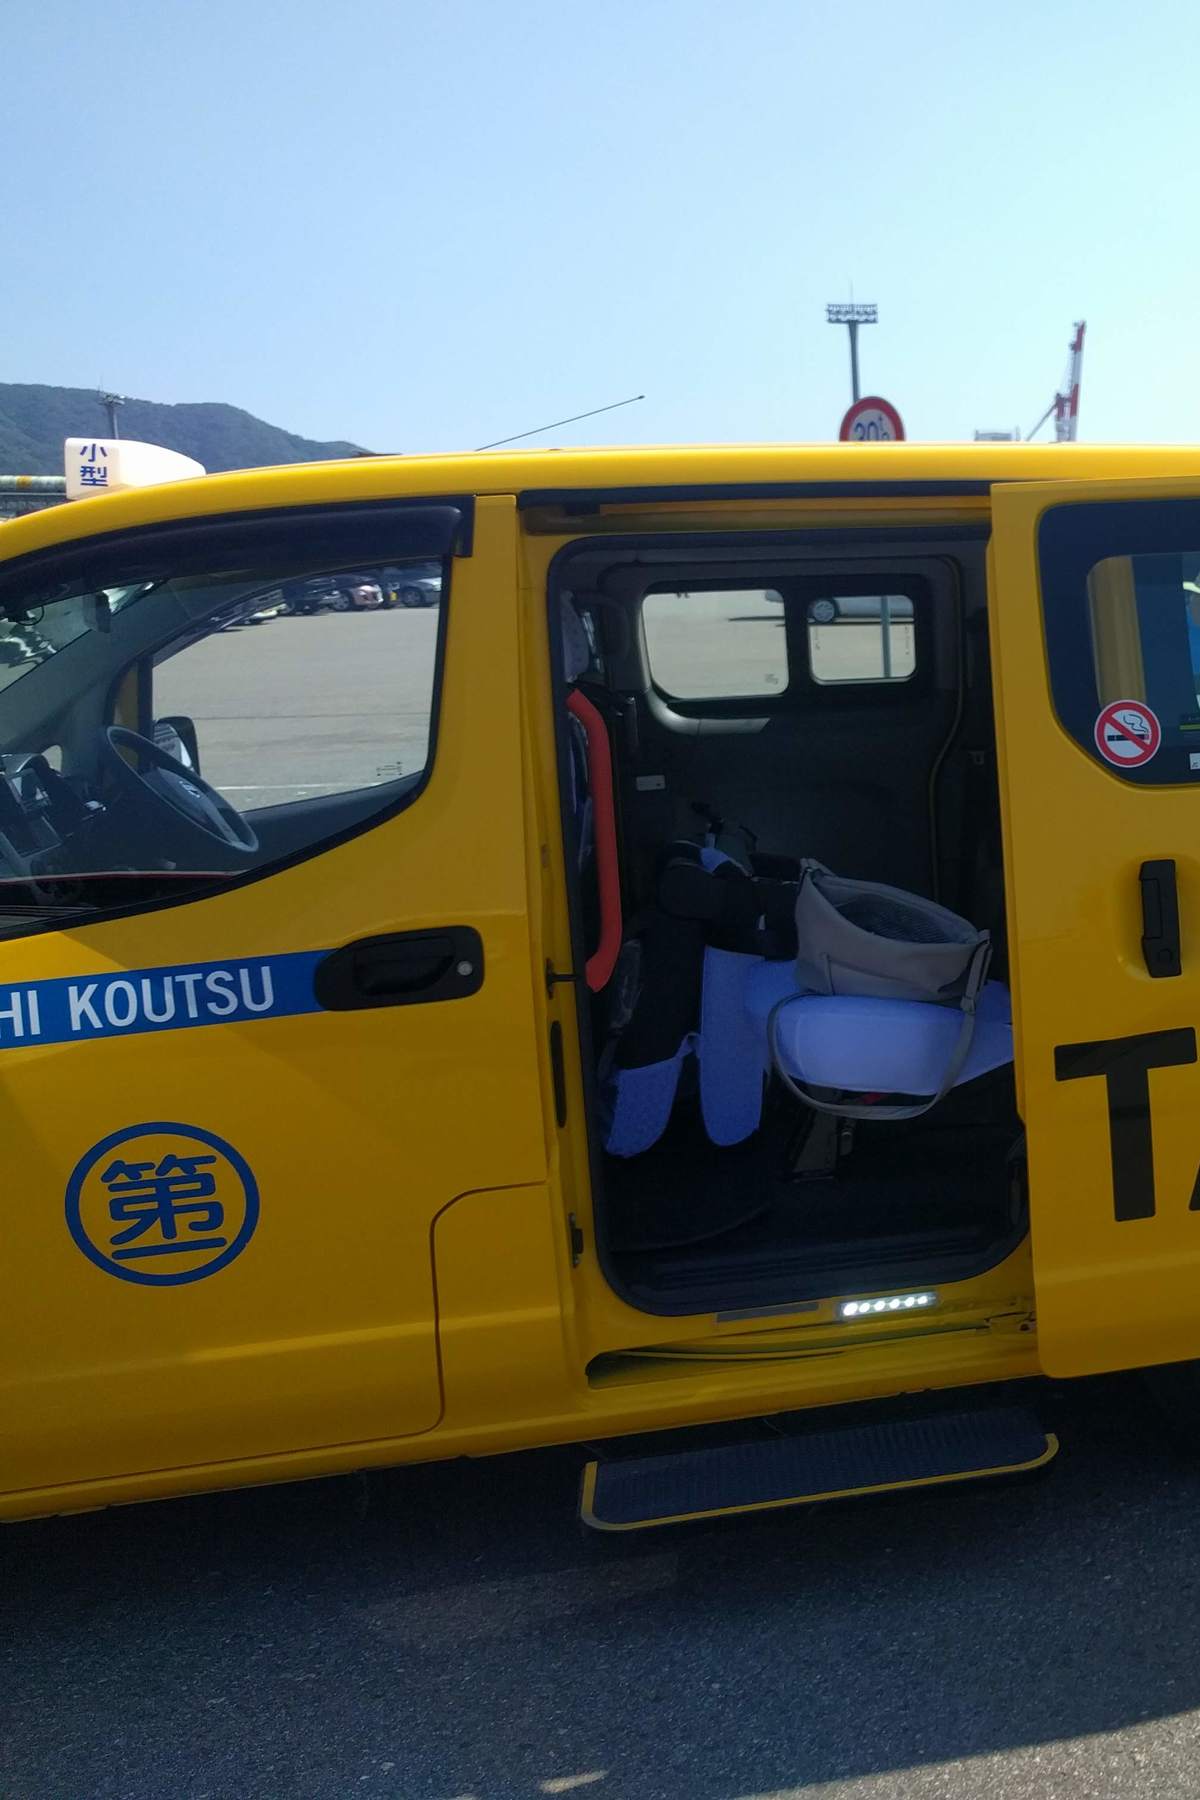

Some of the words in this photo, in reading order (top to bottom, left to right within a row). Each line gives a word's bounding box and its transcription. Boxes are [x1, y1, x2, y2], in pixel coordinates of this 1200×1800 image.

[80, 443, 109, 487] 小型
[0, 990, 41, 1037] HI
[68, 966, 275, 1031] KOUTSU
